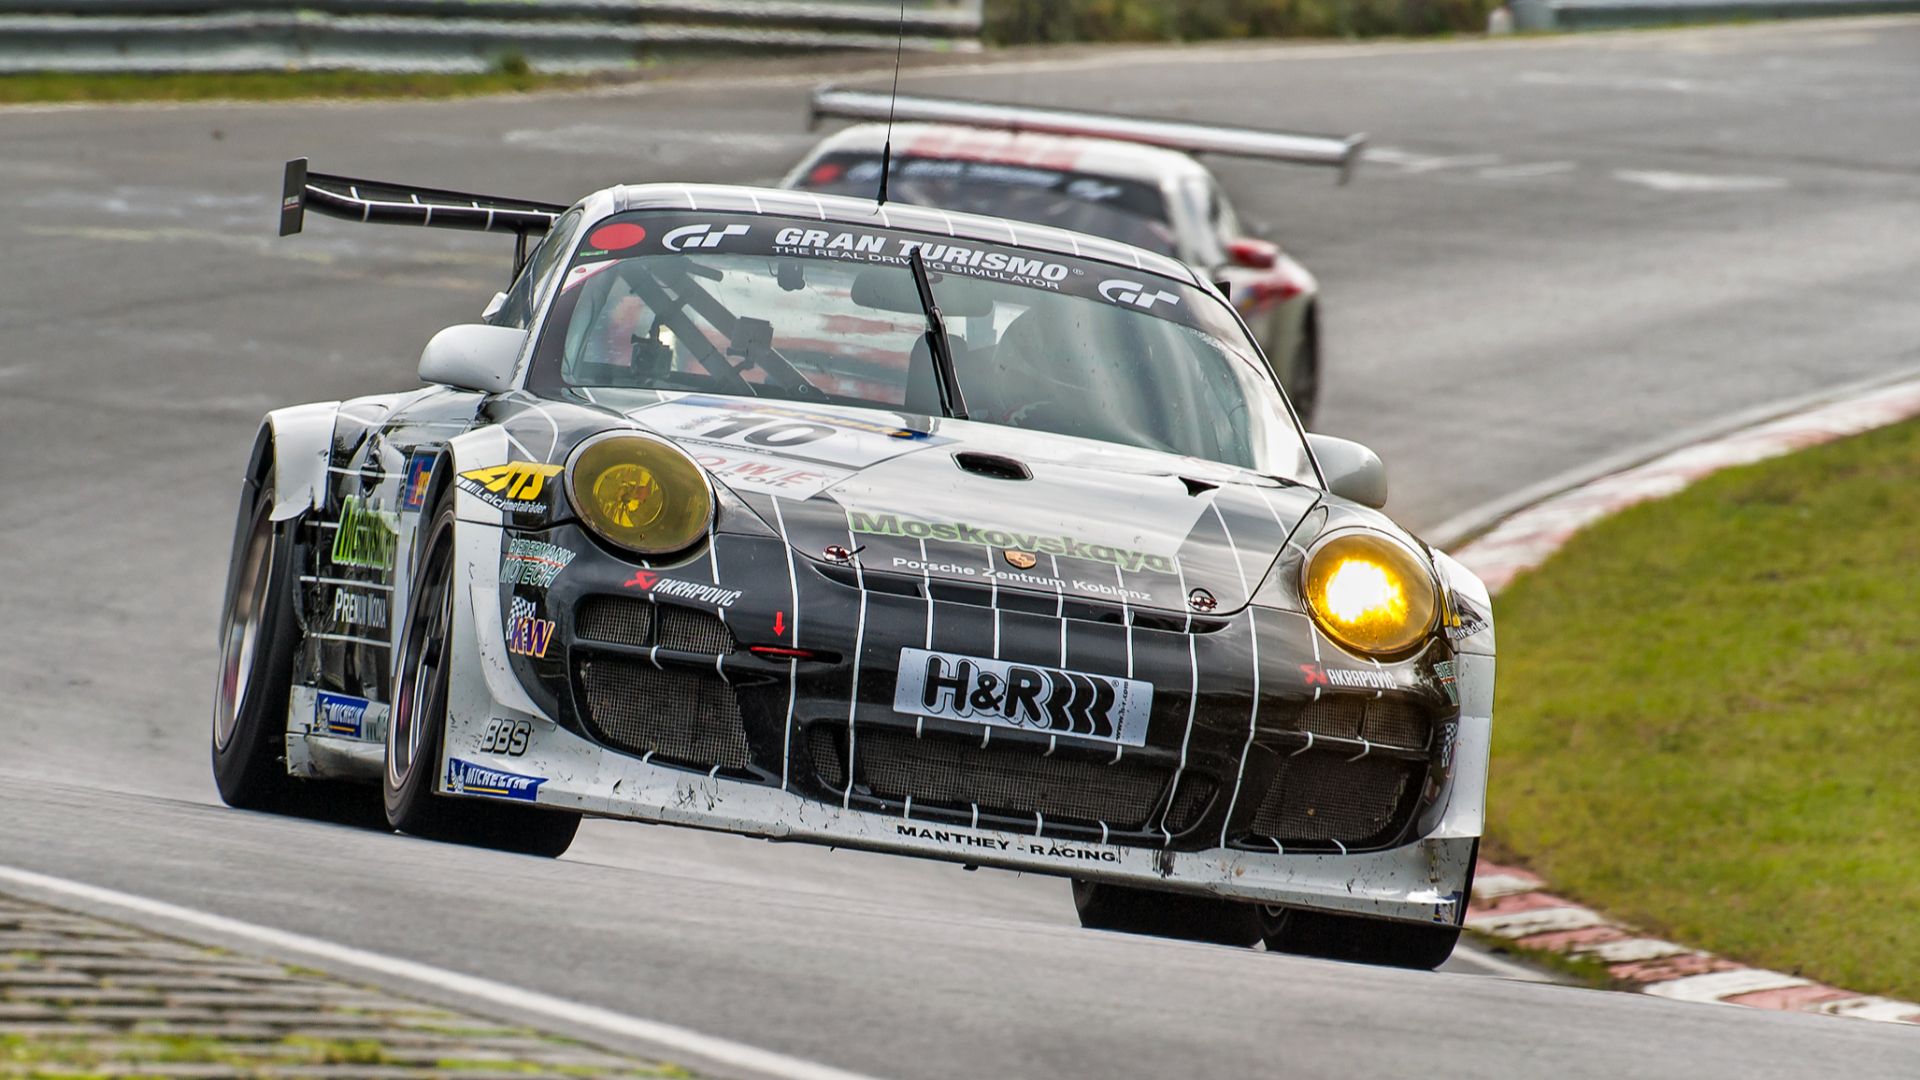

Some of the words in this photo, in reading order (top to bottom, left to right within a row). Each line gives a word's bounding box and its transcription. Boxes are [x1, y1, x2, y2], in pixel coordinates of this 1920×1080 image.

[772, 246, 810, 255] THE
[815, 249, 865, 261] REAL
[868, 254, 946, 271] DRIVNG
[951, 265, 1059, 290] SIMULATOR
[774, 227, 887, 254] GRAN
[899, 239, 1069, 282] TURISMO
[700, 416, 837, 447] 10
[848, 511, 1178, 575] Moskovskaya
[893, 557, 974, 575] Porsche
[983, 567, 1066, 588] Zentrum
[1073, 579, 1151, 601] Koblenz
[509, 616, 556, 659] KW
[480, 718, 532, 757] BBS
[897, 825, 1010, 850] MANTHEY
[1029, 844, 1117, 863] RACING
